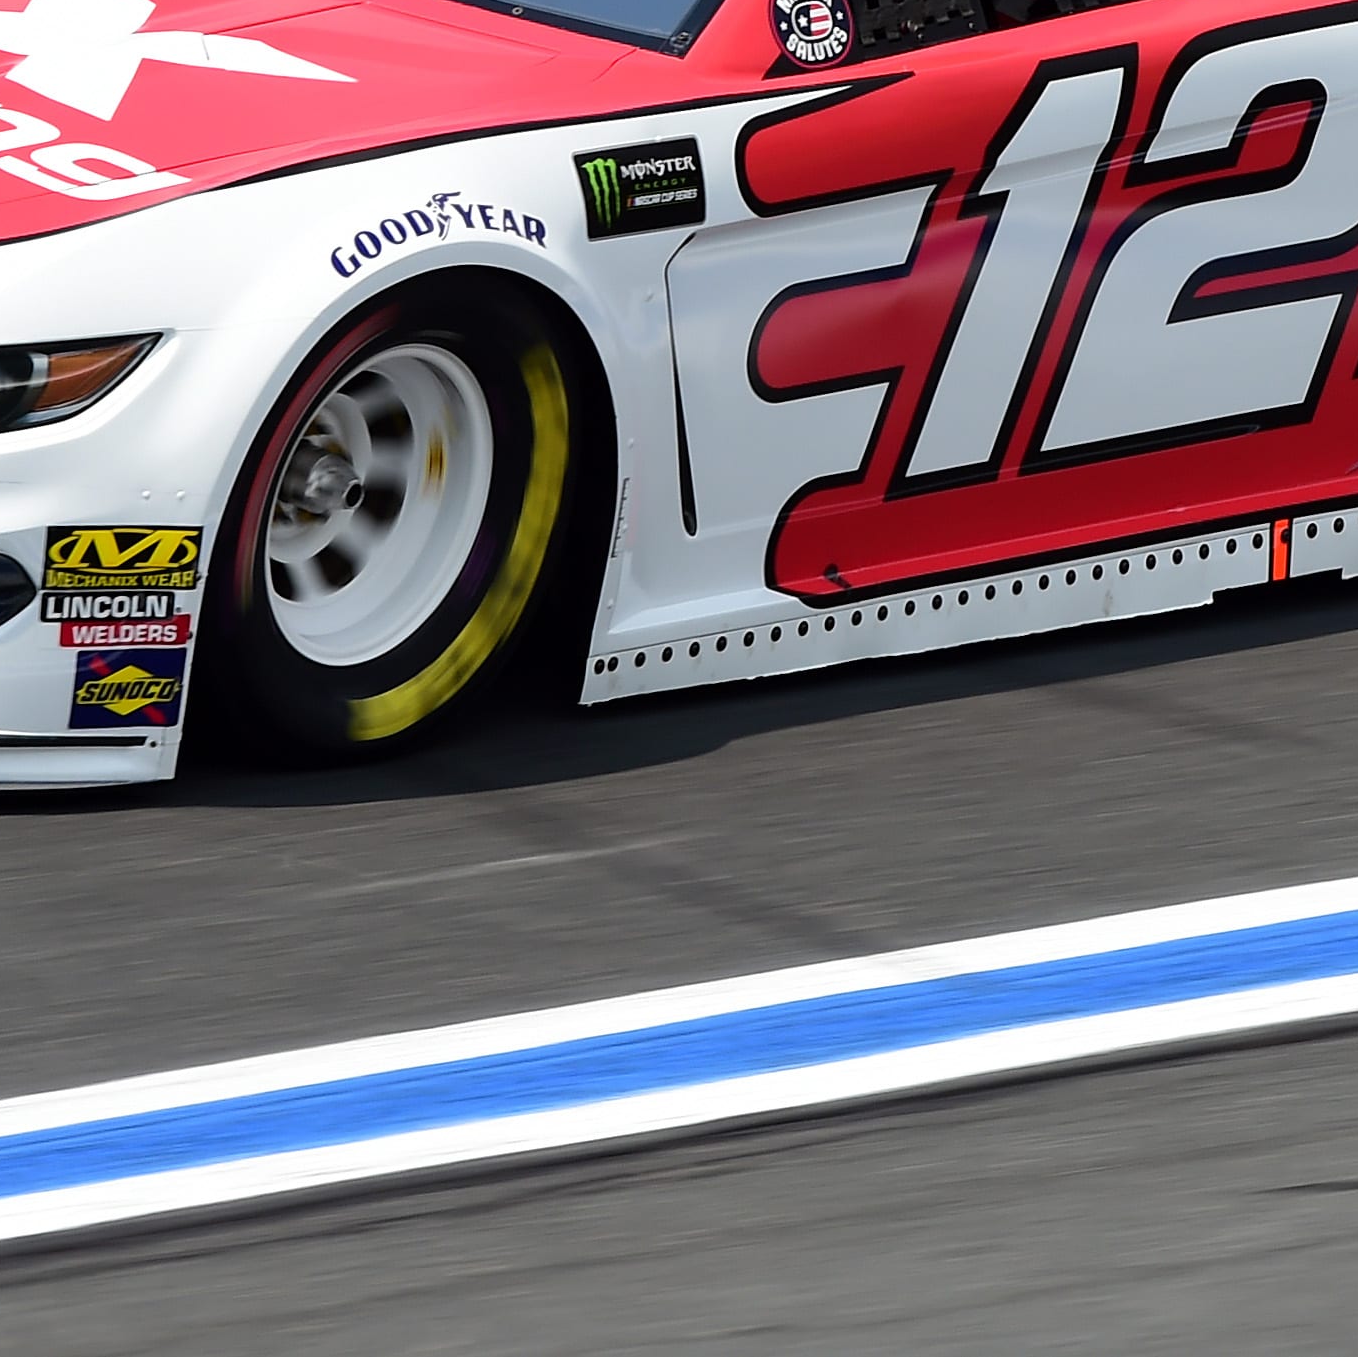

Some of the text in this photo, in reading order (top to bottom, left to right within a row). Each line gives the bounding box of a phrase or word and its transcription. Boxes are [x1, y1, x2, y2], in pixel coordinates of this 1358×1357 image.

[786, 26, 848, 62] SALUTES
[620, 156, 696, 179] MONSTER
[634, 178, 686, 190] ENERGY
[331, 191, 546, 278] GOODYEAR
[45, 569, 194, 588] MECHANIX WEAR
[45, 595, 169, 619] LINCOLN
[72, 625, 178, 644] WELDERS
[80, 680, 177, 702] SUNOCO
